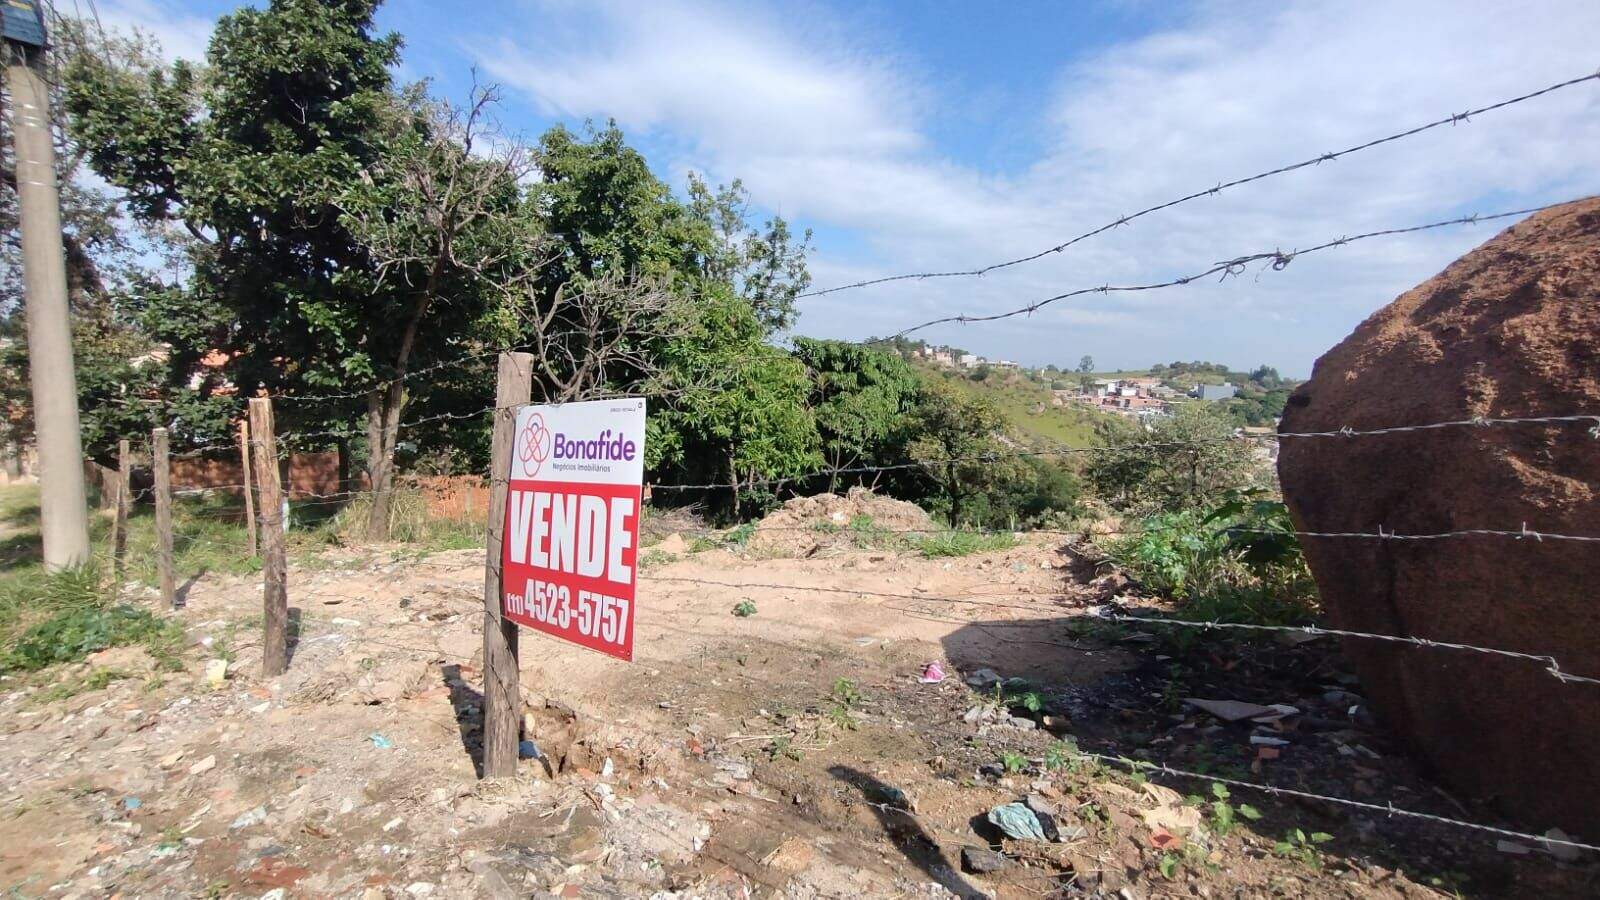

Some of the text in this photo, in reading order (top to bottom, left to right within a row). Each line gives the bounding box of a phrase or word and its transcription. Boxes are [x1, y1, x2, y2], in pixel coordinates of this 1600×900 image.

[553, 429, 635, 461] Bonafide
[510, 490, 634, 584] VENDE
[524, 579, 629, 645] 4523-5757
